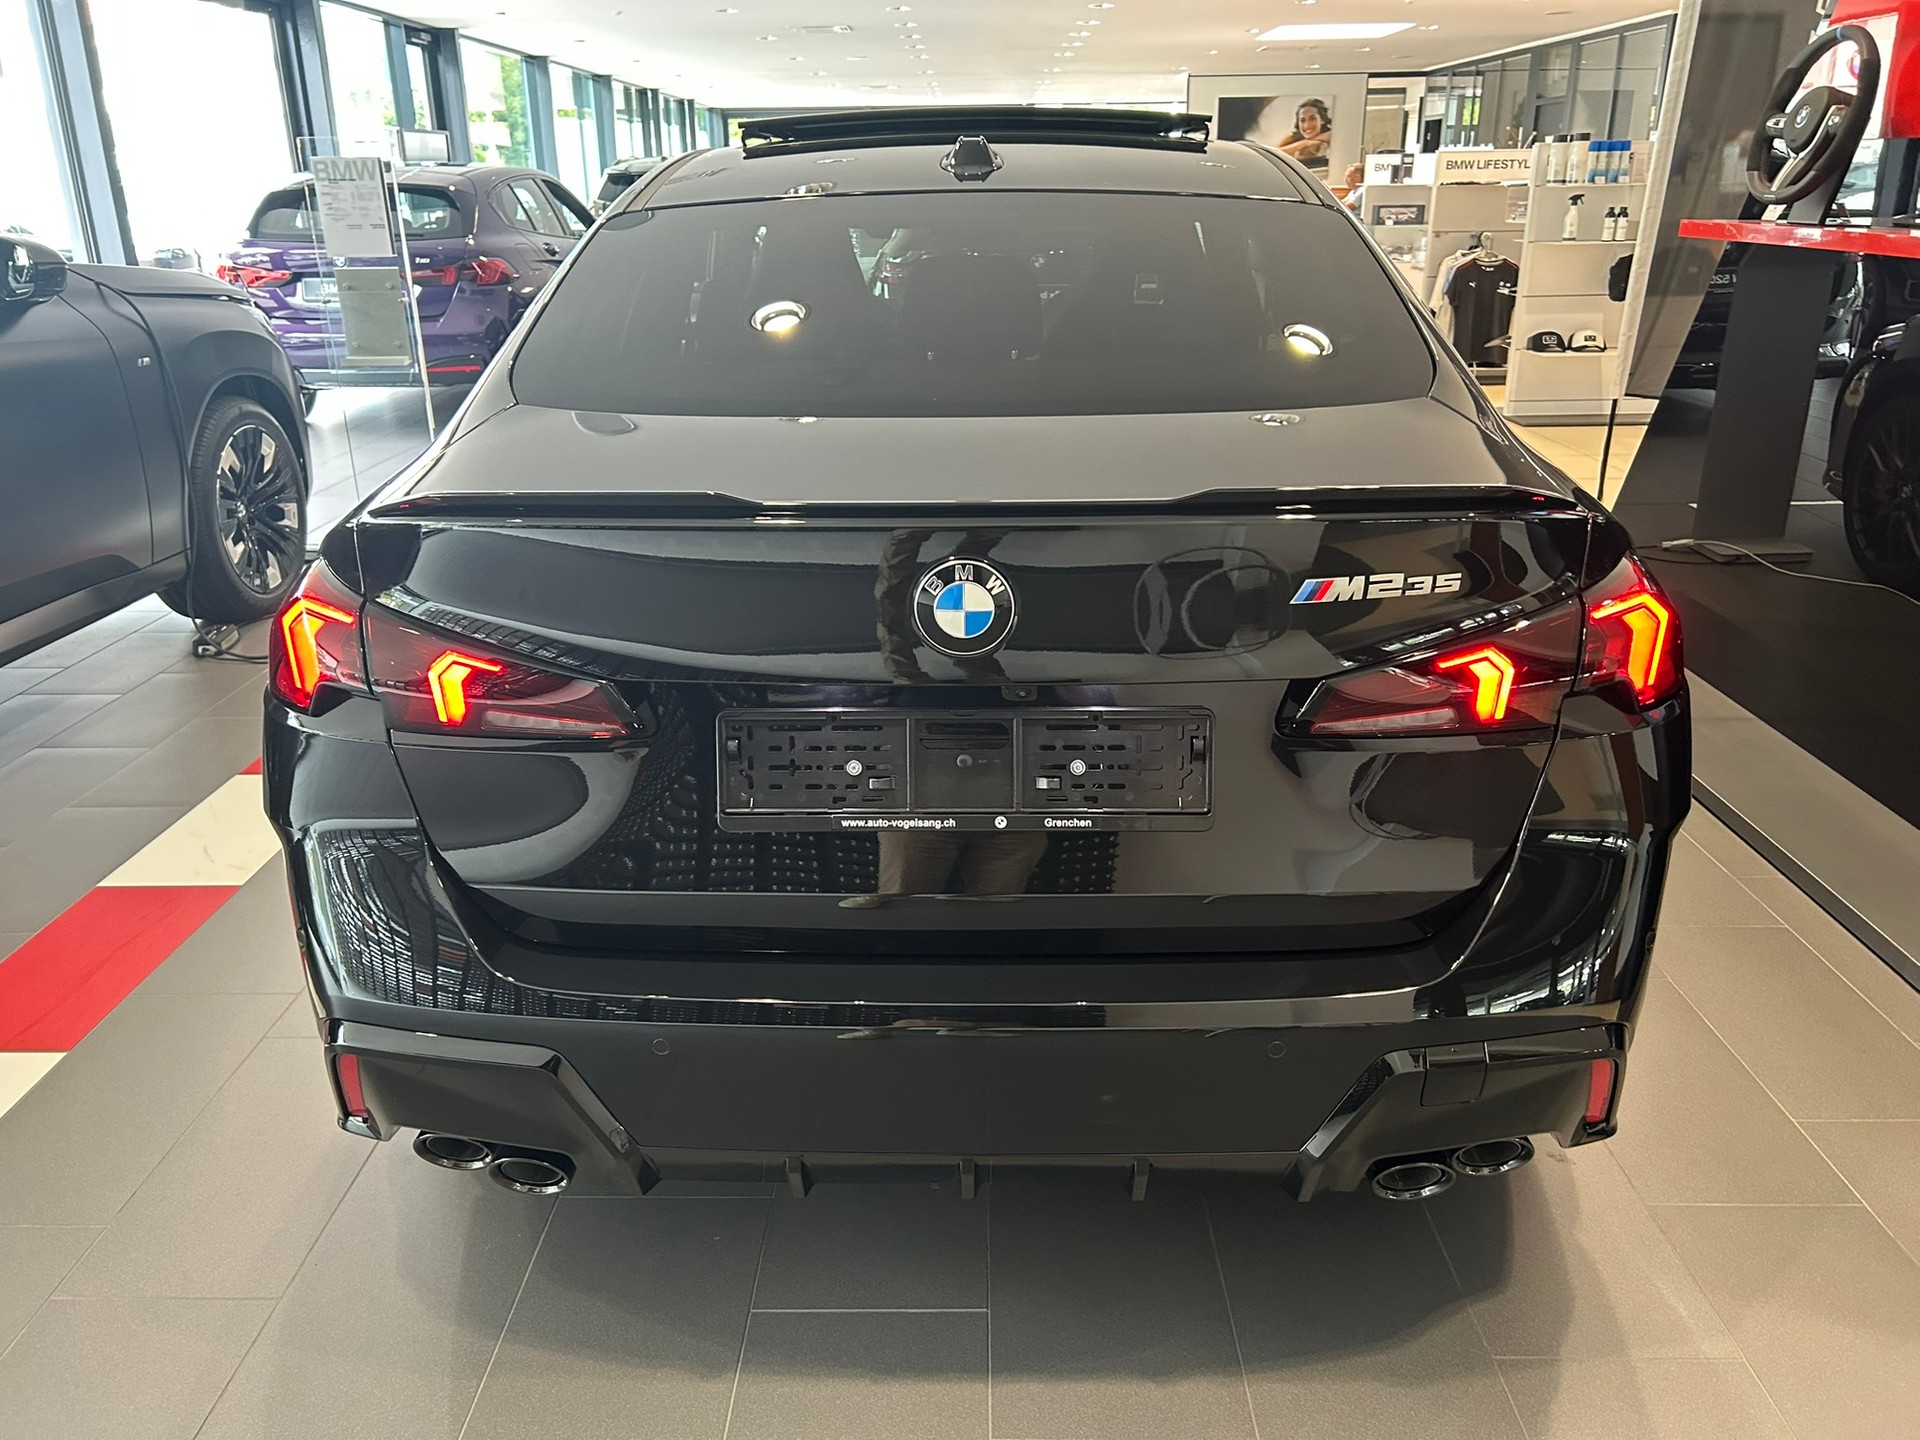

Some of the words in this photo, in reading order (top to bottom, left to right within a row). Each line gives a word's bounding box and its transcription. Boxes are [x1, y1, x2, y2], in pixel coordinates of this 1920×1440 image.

[313, 160, 377, 181] BMW
[1374, 163, 1394, 172] BM
[1446, 159, 1475, 170] BMW
[924, 564, 1006, 597] BMW
[1316, 572, 1463, 603] M235
[841, 818, 956, 829] www.auto-vogelsang.ch
[1044, 818, 1092, 828] Grenchen
